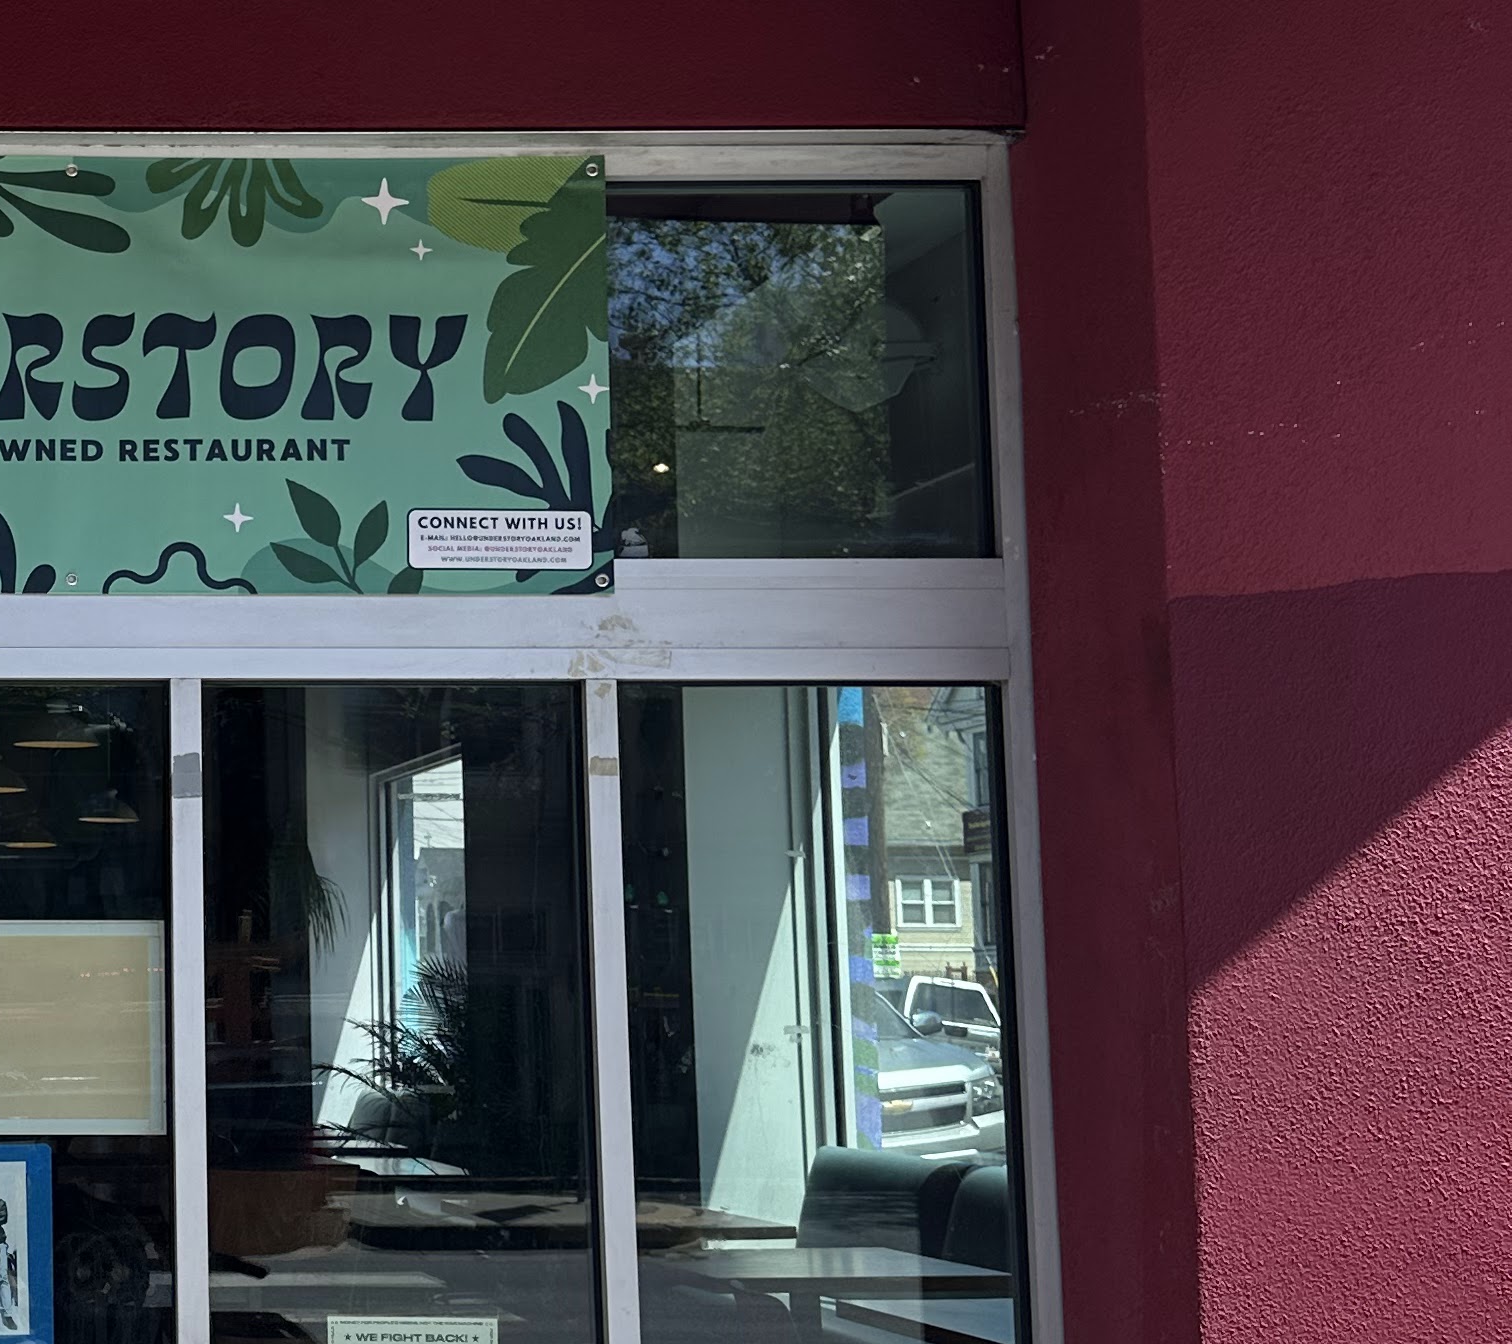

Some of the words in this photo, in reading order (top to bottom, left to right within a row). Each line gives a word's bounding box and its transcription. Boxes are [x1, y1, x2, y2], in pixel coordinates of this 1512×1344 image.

[118, 437, 351, 463] RESTAURANT
[417, 516, 499, 530] CONNECT
[504, 517, 548, 530] WITH
[555, 517, 582, 531] US!
[355, 1333, 378, 1342] WE
[380, 1333, 423, 1343] FIGHT
[425, 1333, 469, 1343] BACK!
